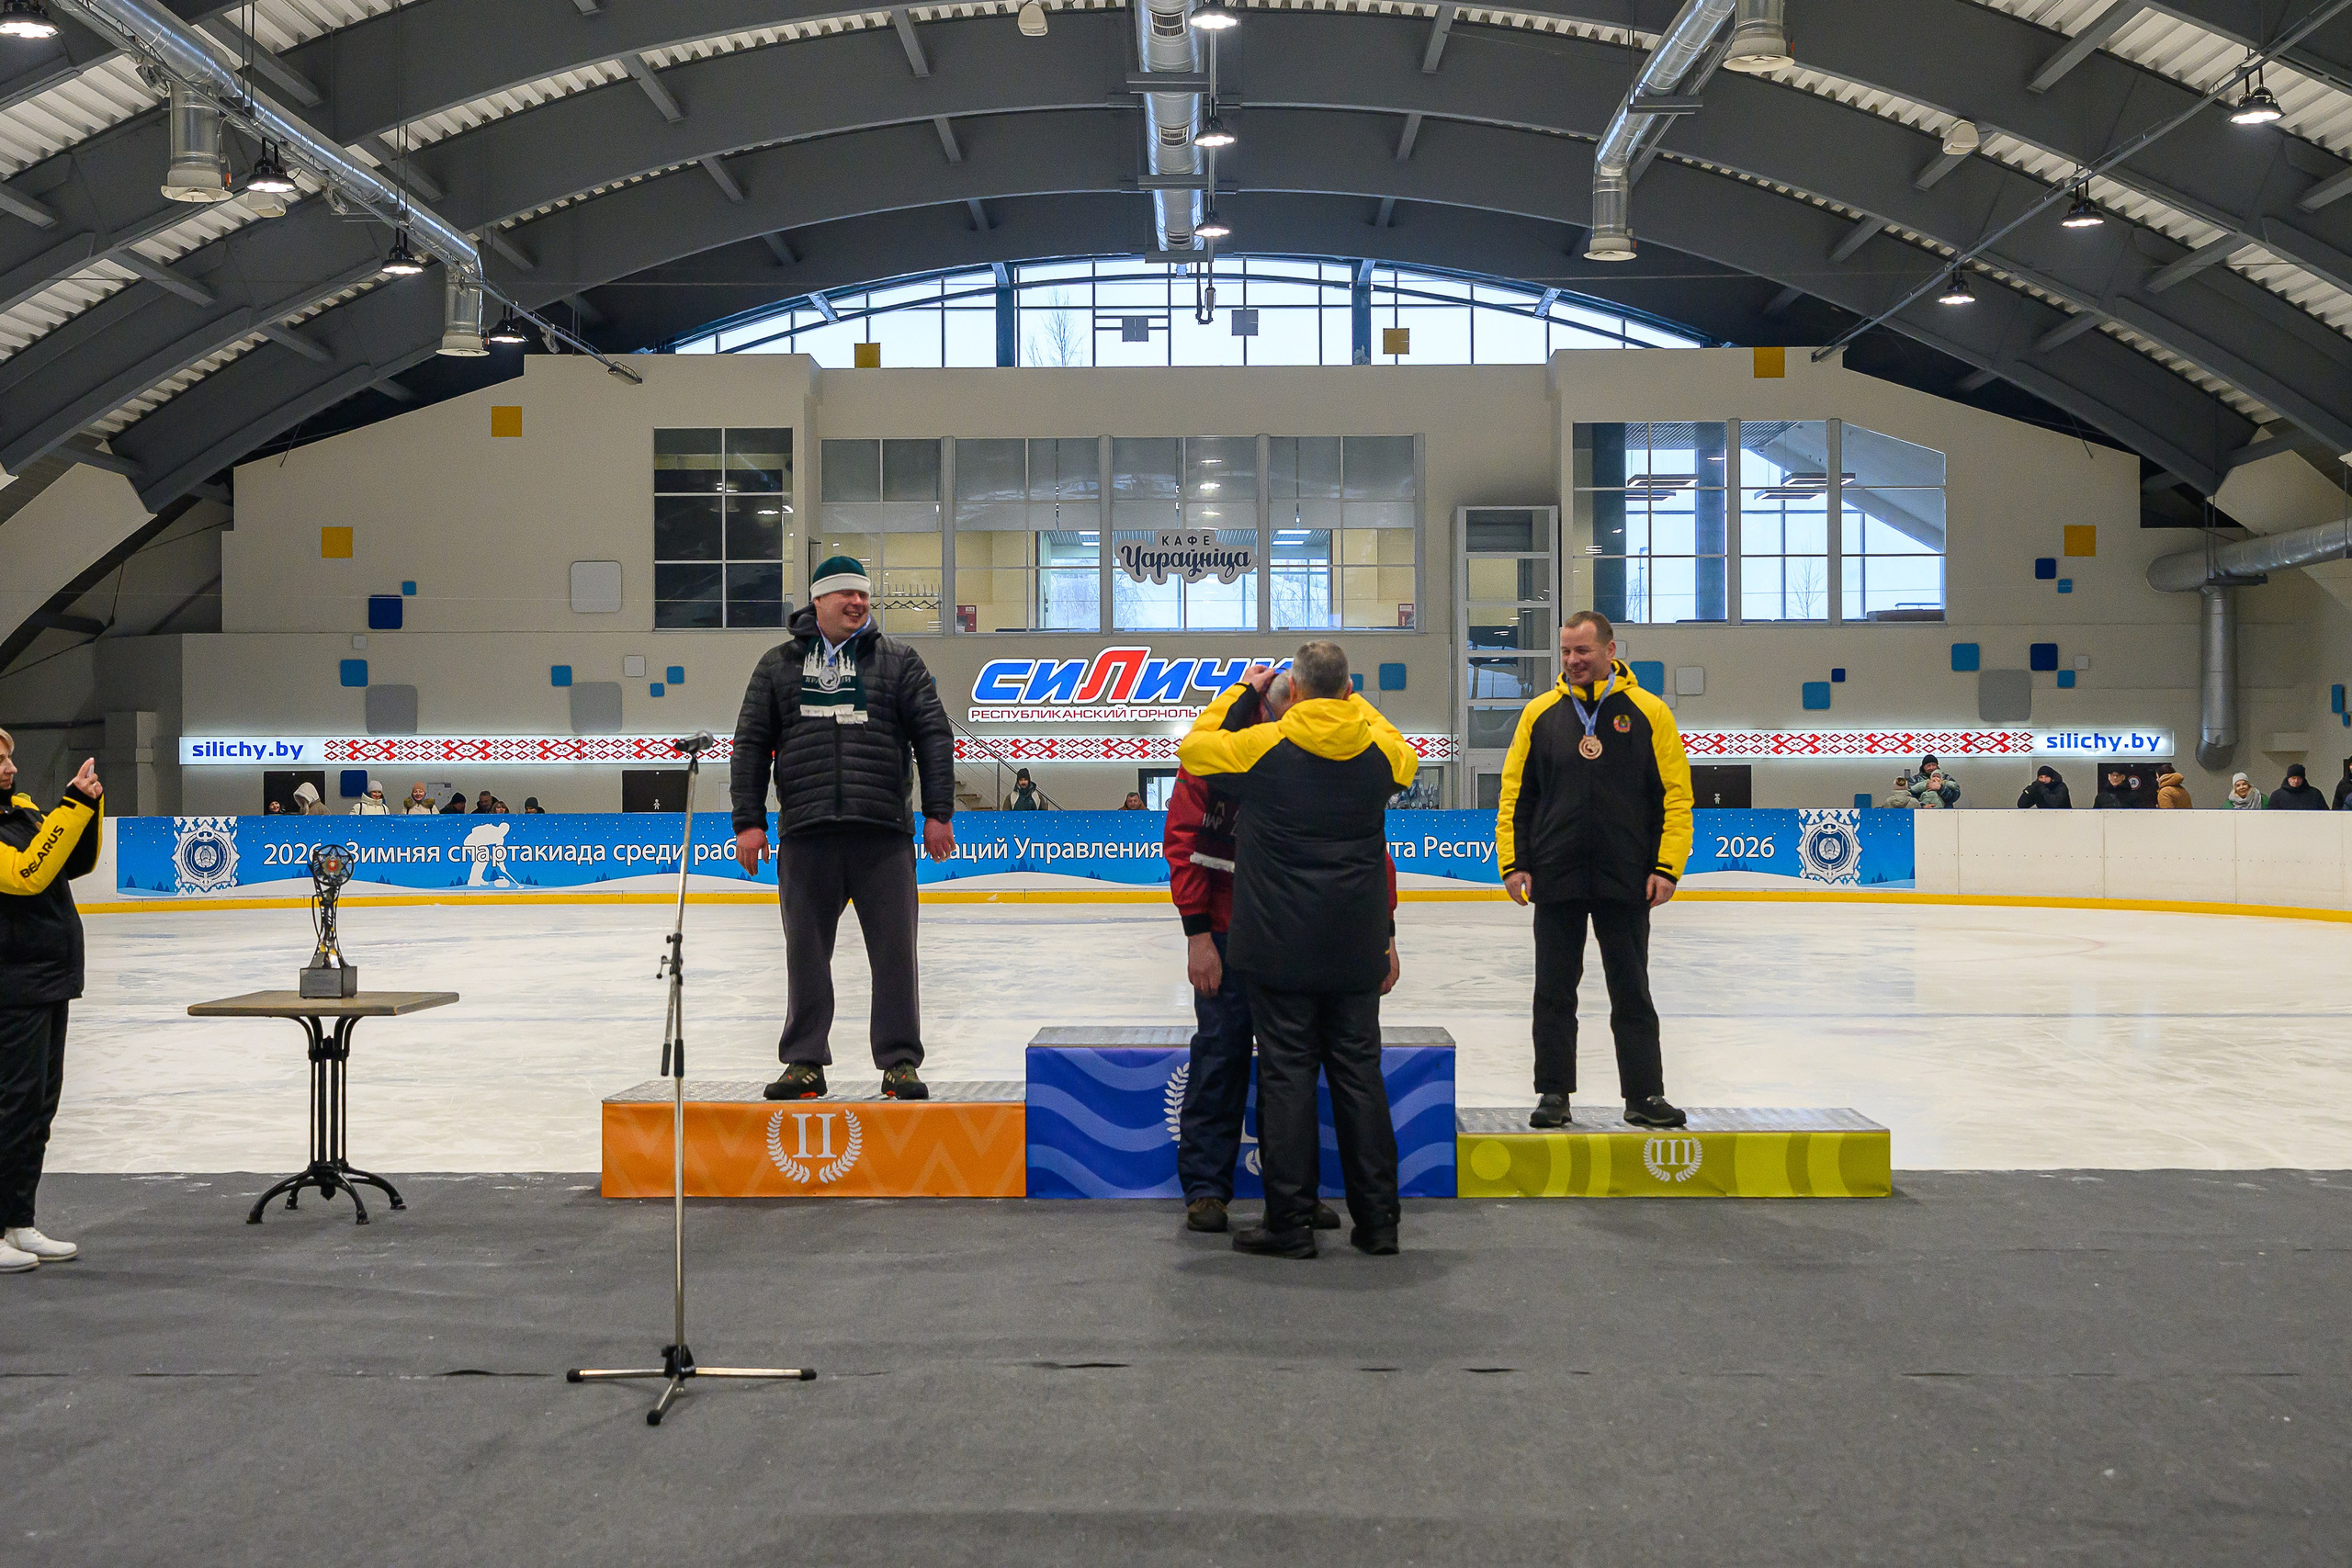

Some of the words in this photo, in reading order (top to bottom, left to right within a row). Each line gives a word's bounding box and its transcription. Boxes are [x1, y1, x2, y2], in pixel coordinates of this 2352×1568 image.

[1161, 536, 1210, 546] КАФЕ
[1120, 545, 1251, 579] Чараўніца
[971, 706, 1126, 719] РЕСПУБЛИКАНСКИЙ
[1130, 708, 1204, 718] ГОРНОЛЫ
[192, 740, 304, 760] silichy.by
[2046, 732, 2161, 751] silichy.by
[20, 825, 64, 878] BELARUS
[345, 841, 440, 863] Зимняя
[447, 844, 606, 866] спартакиада
[1013, 837, 1163, 864] Управления
[1424, 836, 1498, 863] Респу
[1715, 836, 1775, 858] 2026
[792, 1113, 837, 1158] II
[1654, 1139, 1692, 1166] III
